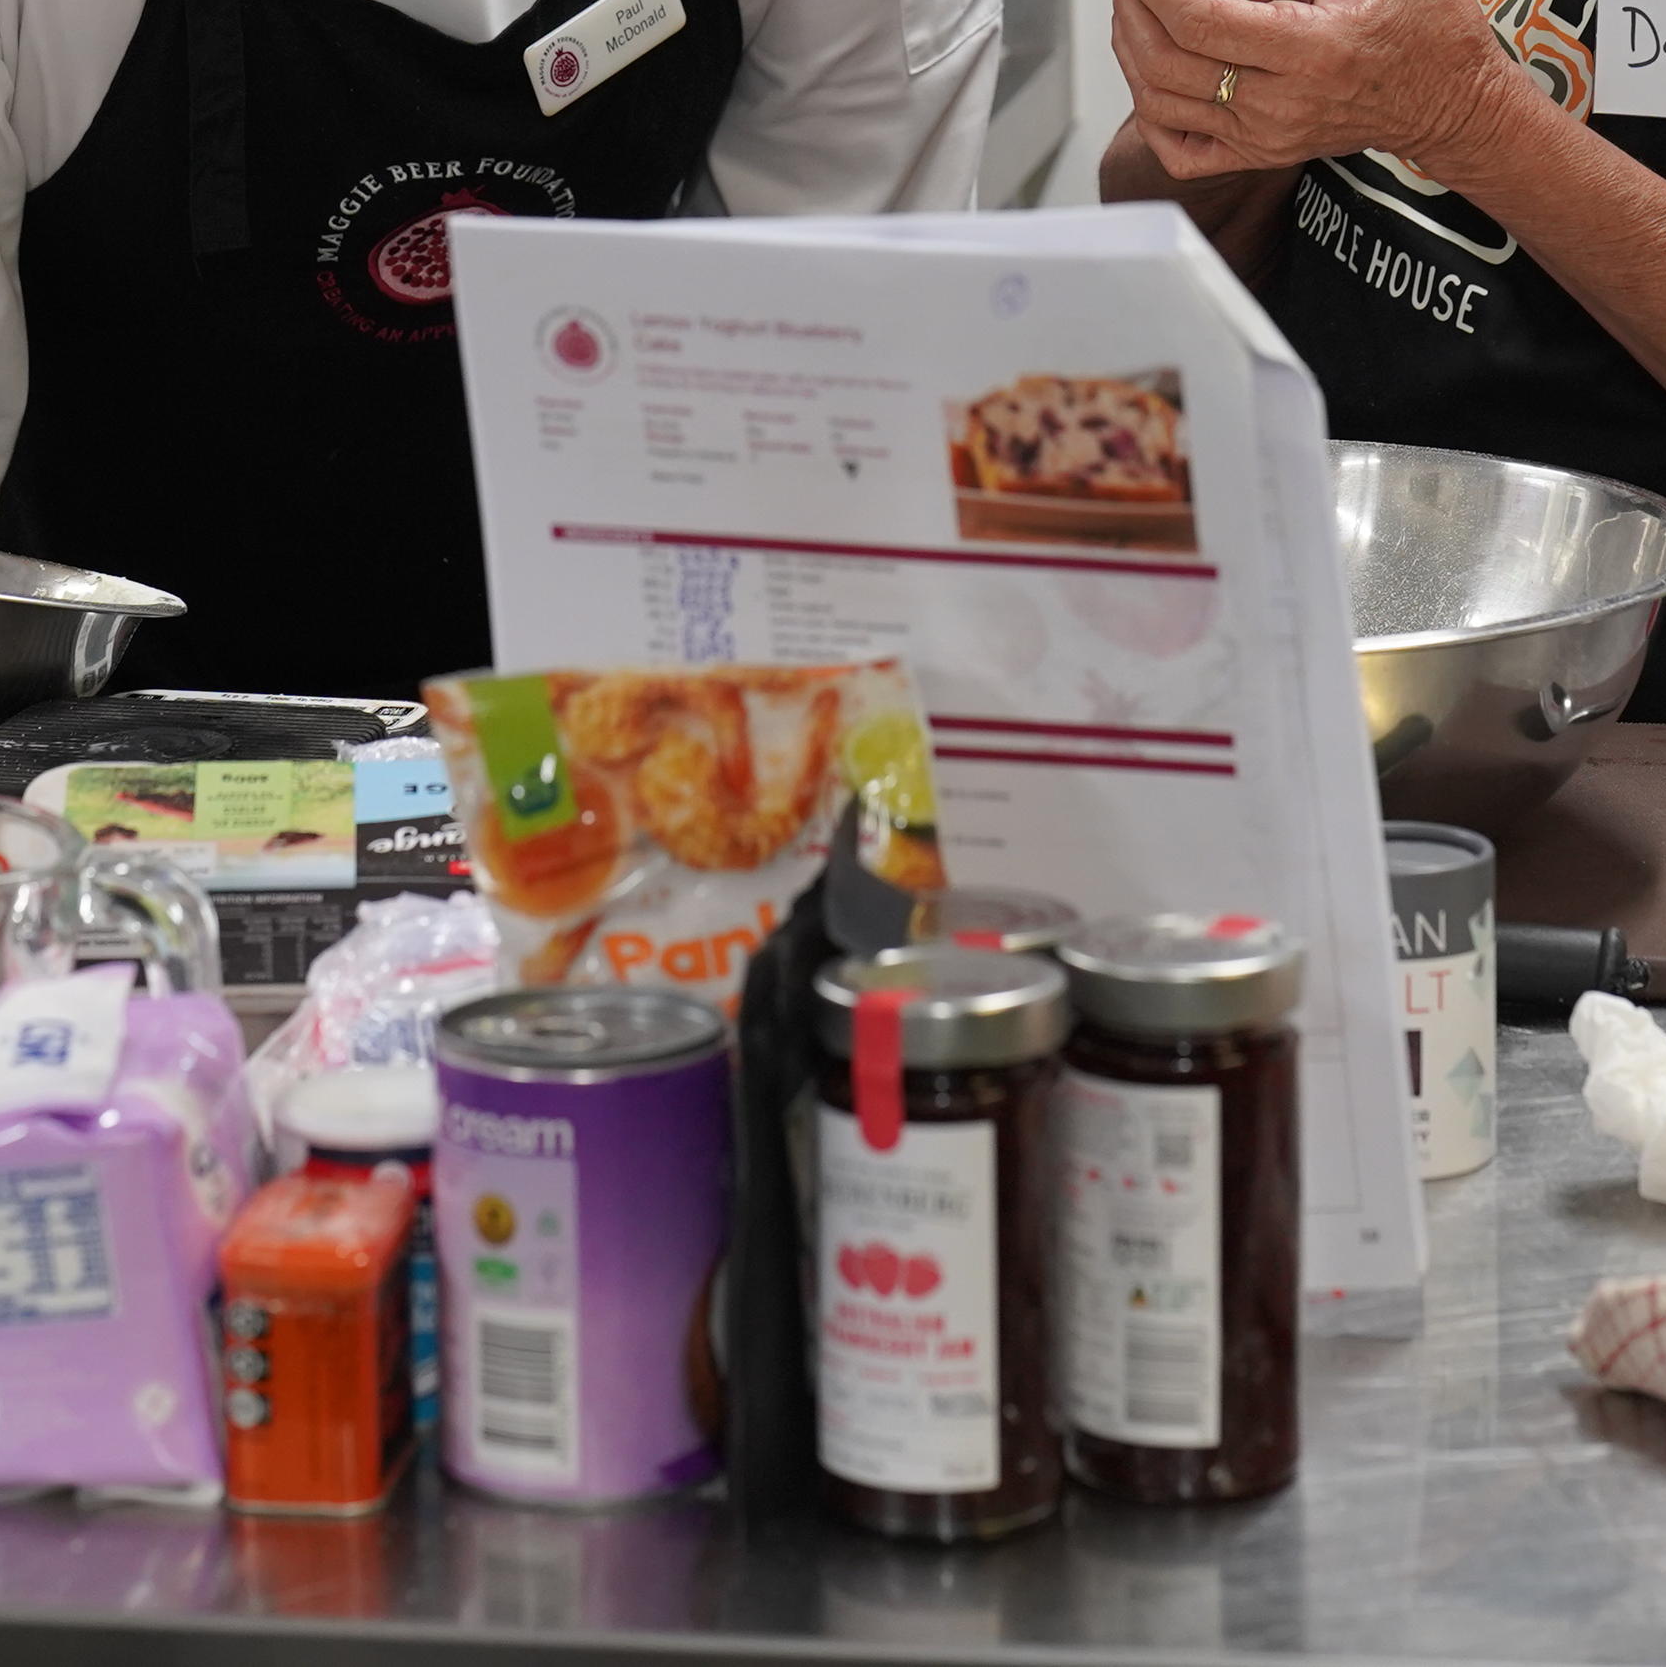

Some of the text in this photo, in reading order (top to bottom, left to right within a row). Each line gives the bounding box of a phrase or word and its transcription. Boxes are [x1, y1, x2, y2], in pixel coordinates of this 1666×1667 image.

[605, 4, 668, 54] McDonald
[317, 157, 576, 262] MAGGIE BEER FOUNDATIO
[1294, 172, 1490, 334] PURPLE HOUSE
[448, 1099, 575, 1159] cream
